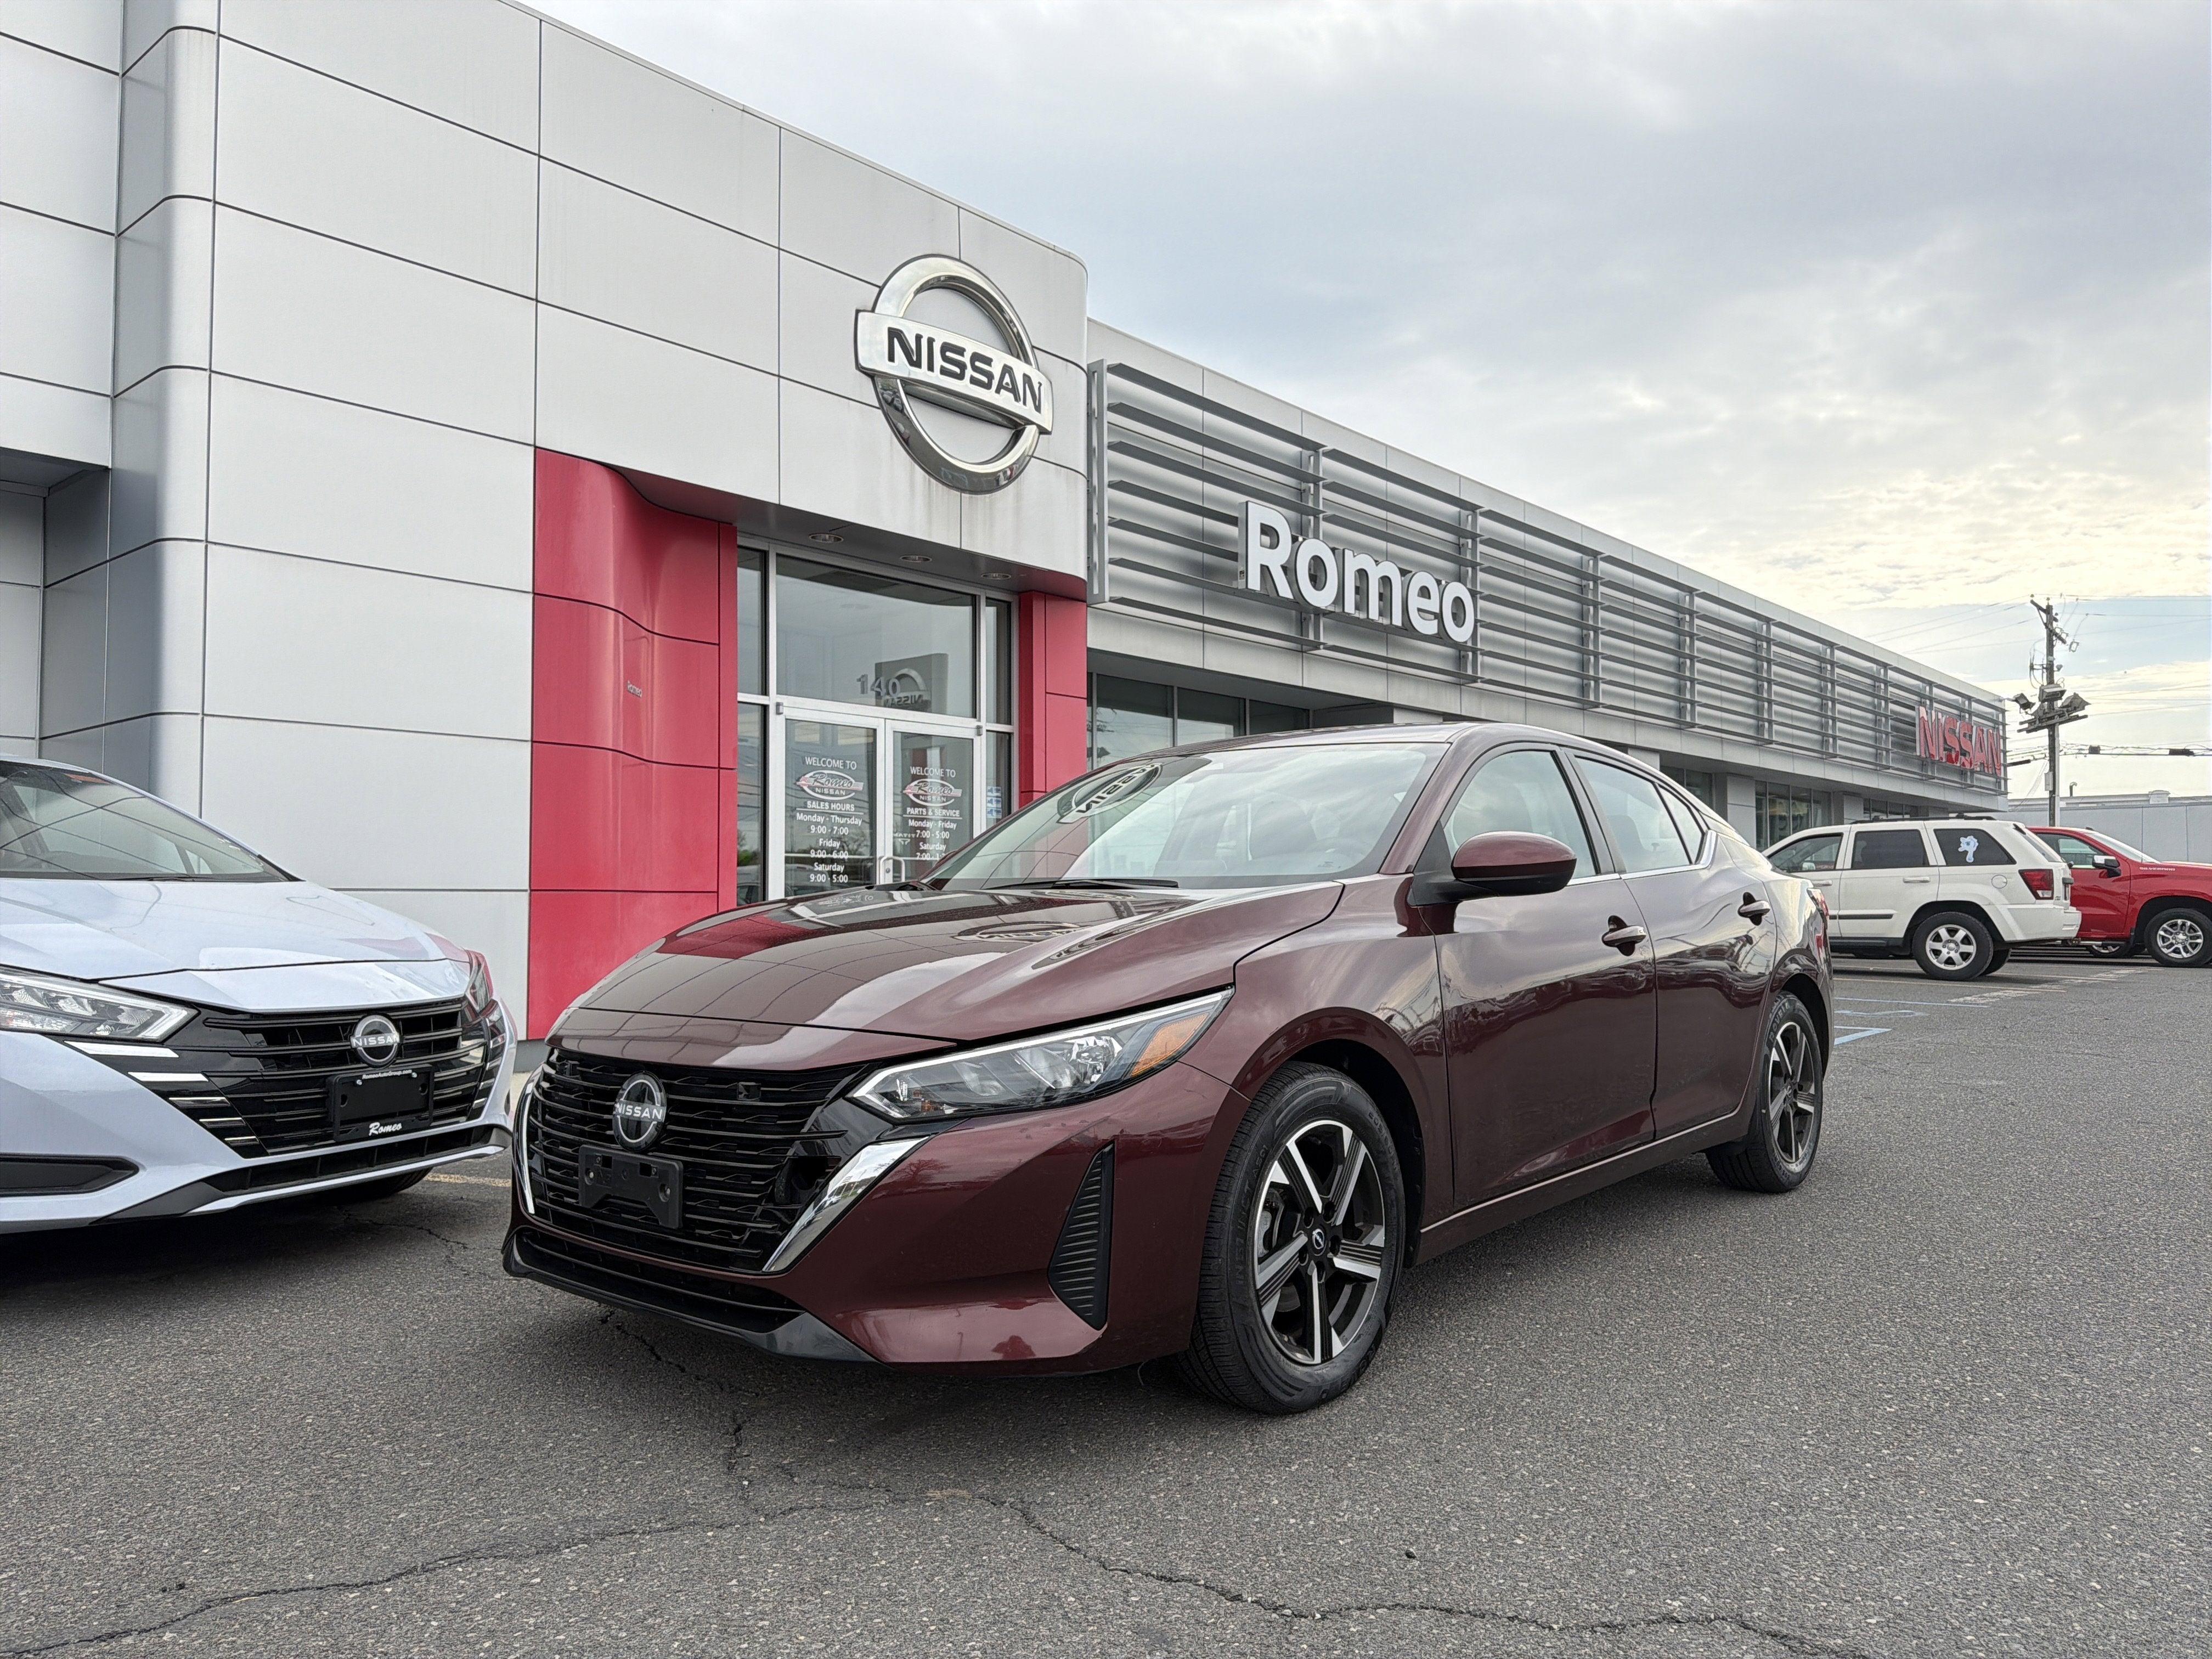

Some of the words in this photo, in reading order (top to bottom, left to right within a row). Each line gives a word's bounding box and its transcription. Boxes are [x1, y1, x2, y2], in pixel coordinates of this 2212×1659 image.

[887, 327, 1043, 414] NISSAN
[1240, 500, 1475, 643] Romeo
[856, 674, 900, 698] 140
[1917, 706, 2002, 777] NISSAN
[805, 757, 844, 769] WELCOME
[845, 760, 857, 770] TO
[910, 766, 944, 777] WELCOME
[946, 769, 956, 778] TO
[809, 772, 854, 788] Romeo
[815, 787, 845, 795] NISSAN
[914, 780, 953, 794] Romeo
[806, 801, 829, 810] SALES
[831, 803, 855, 811] HOURS
[906, 807, 927, 815] PARTS
[934, 809, 960, 817] SERVICE
[796, 812, 825, 823] Monday
[831, 815, 862, 826] Thursday
[909, 819, 933, 828] Monday
[938, 821, 957, 830] Friday
[810, 825, 827, 834] 9:00
[833, 826, 849, 835] 7:00
[916, 830, 930, 838] 7:00
[936, 831, 950, 839] 5:00
[819, 838, 840, 849] Friday
[919, 842, 946, 851] Saturday
[810, 849, 827, 858] 9:00
[833, 850, 849, 859] 6:00
[814, 862, 845, 873] Saturday
[810, 873, 826, 883] 9:00
[832, 874, 848, 883] 5:00
[352, 1031, 400, 1047] NISSAN
[362, 1069, 413, 1080] RomeoAutoGroup.com
[615, 1102, 663, 1120] NISSAN
[369, 1122, 403, 1136] Romeo
